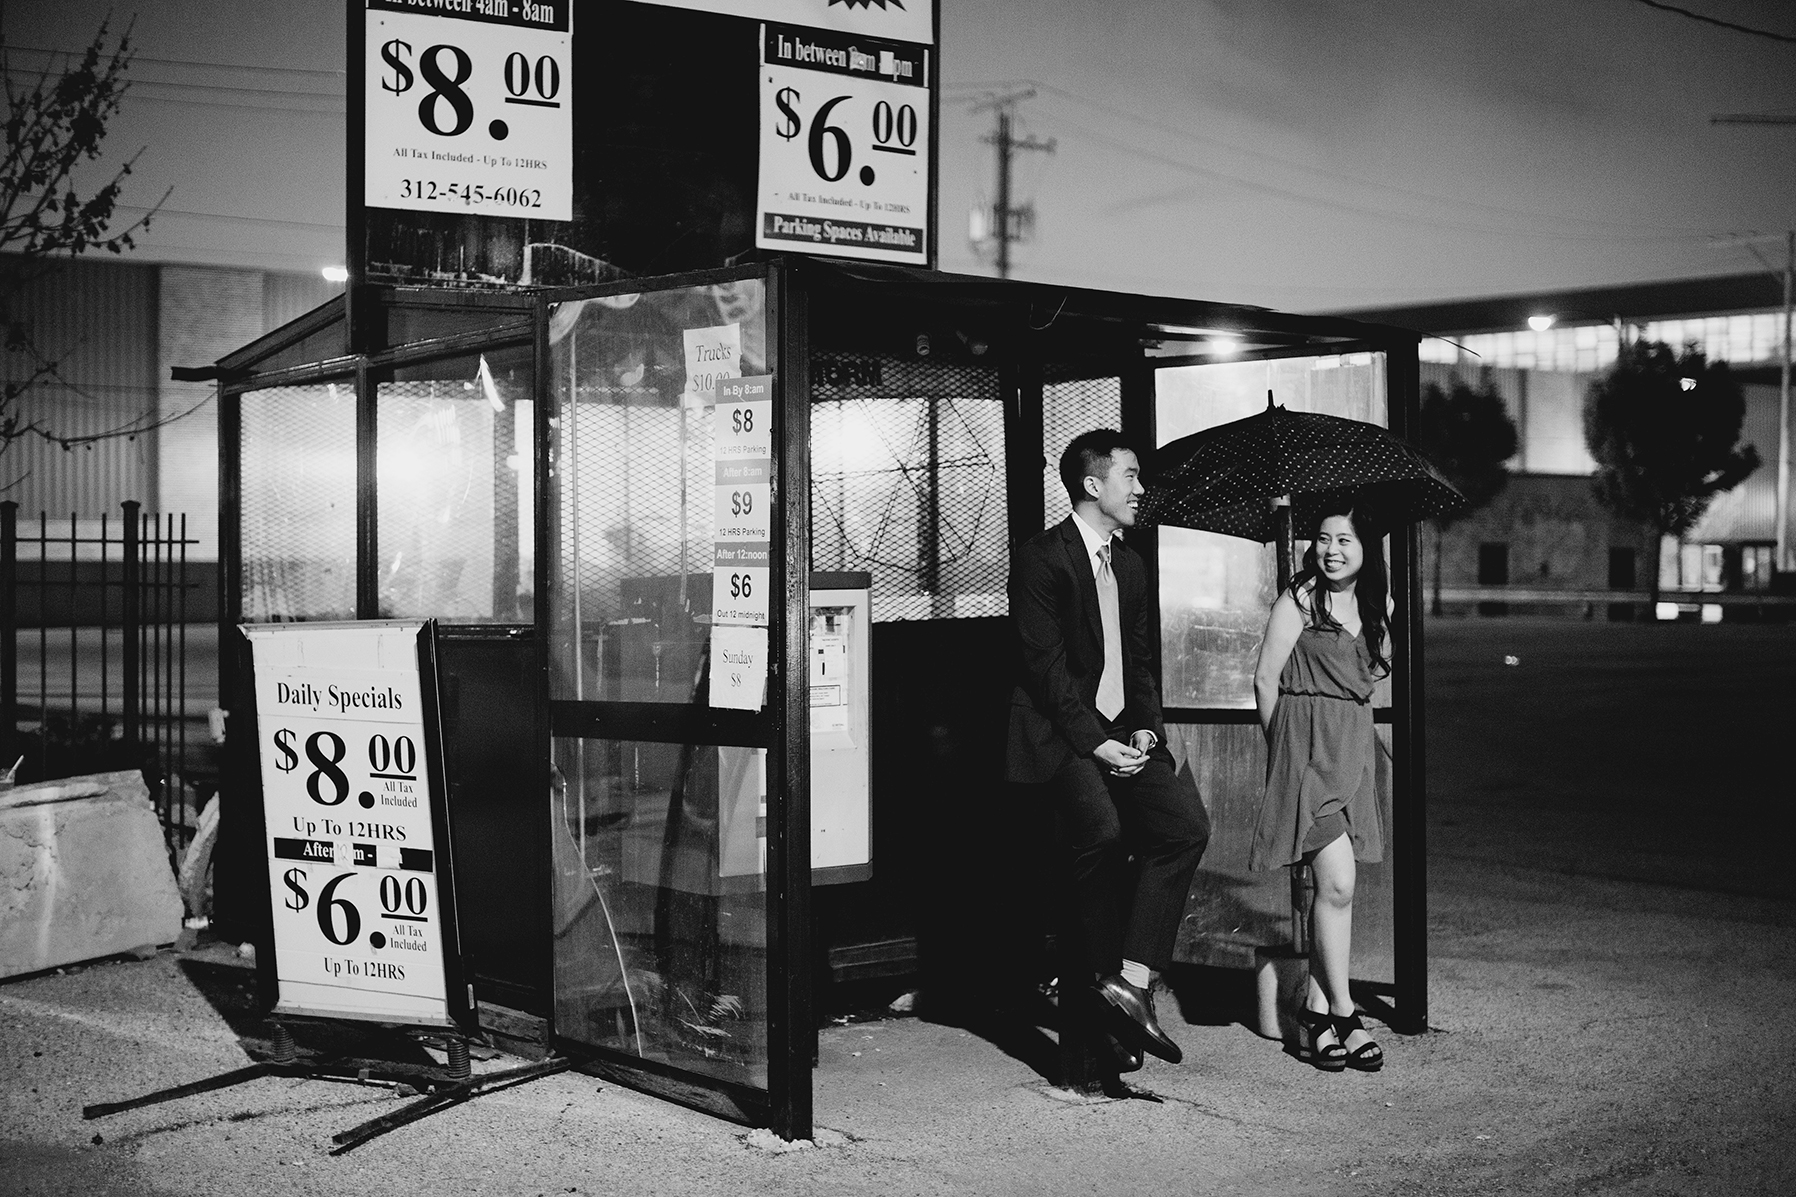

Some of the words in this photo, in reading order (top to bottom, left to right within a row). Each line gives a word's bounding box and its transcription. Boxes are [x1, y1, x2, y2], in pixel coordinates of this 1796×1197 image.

[522, 0, 554, 24] 8am
[778, 34, 792, 59] In
[795, 37, 847, 67] between
[380, 38, 561, 141] $8.00
[775, 86, 918, 187] $6.00
[393, 148, 408, 157] All
[411, 149, 428, 159] Tax
[431, 150, 474, 163] Included
[483, 155, 498, 167] Up
[501, 157, 512, 167] To
[515, 158, 548, 169] 12HRS
[400, 179, 542, 208] 312-545-6062
[773, 215, 822, 241] Parking
[823, 220, 863, 243] Spaces
[864, 225, 916, 246] Available
[695, 343, 732, 362] Trucks
[723, 386, 731, 396] In
[732, 385, 743, 397] By
[732, 408, 754, 436] $8
[720, 446, 727, 455] 12
[728, 446, 742, 454] HRS
[742, 445, 767, 455] Parking
[722, 467, 742, 478] After
[731, 490, 753, 518] $9
[719, 528, 727, 536] 12
[727, 528, 741, 536] HRS
[742, 528, 766, 538] Parking
[716, 549, 736, 560] After
[737, 549, 768, 560] 12:noon
[730, 572, 752, 600] $6
[716, 610, 729, 618] Out
[729, 610, 737, 618] 12
[737, 610, 765, 620] midnight
[722, 649, 753, 668] Sunday
[277, 682, 322, 712] Daily
[328, 684, 403, 714] Specials
[273, 727, 417, 809] $8.00
[383, 781, 396, 792] All
[397, 782, 414, 793] Tax
[381, 794, 418, 808] Included
[293, 816, 316, 837] Up
[321, 818, 342, 836] To
[349, 822, 407, 842] 12HRS
[283, 867, 428, 949] $6.00
[392, 925, 405, 936] All
[408, 926, 423, 937] Tax
[390, 938, 427, 952] Included
[324, 957, 341, 977] Up
[344, 959, 359, 975] To
[364, 962, 406, 981] 12HRS
